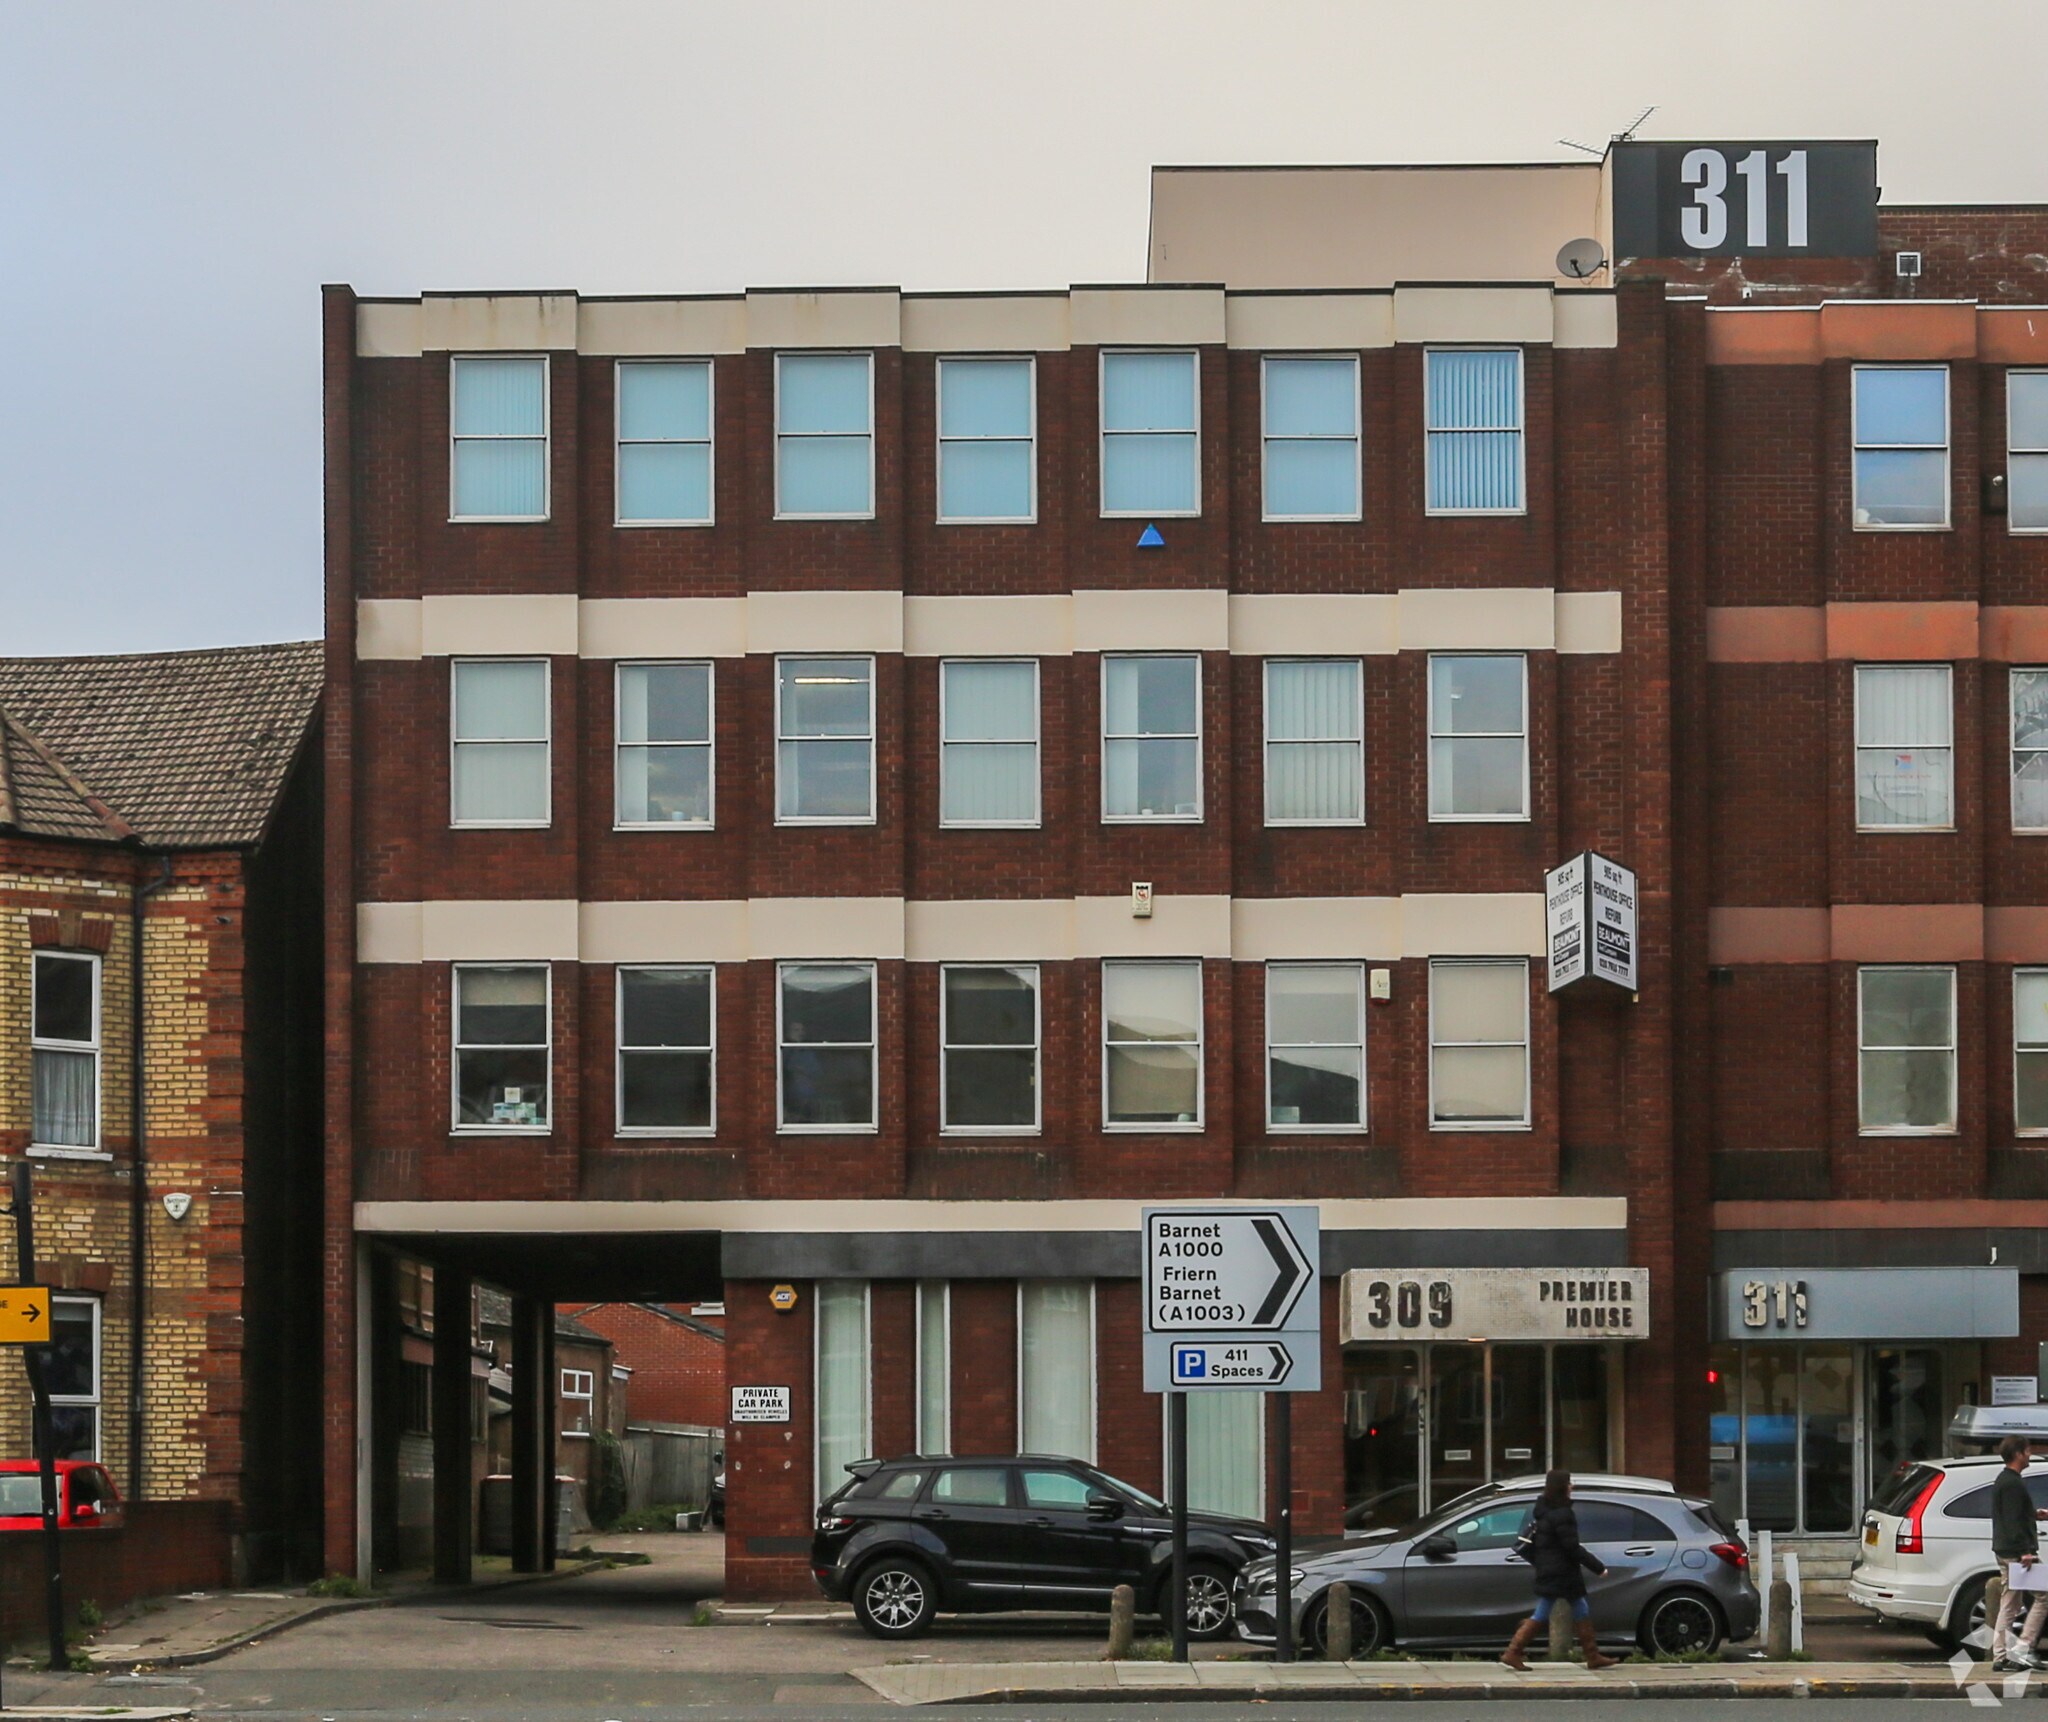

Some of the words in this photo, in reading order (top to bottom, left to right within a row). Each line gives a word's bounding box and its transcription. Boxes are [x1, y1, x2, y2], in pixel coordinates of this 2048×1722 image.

[1681, 148, 1808, 249] 311
[1570, 881, 1583, 900] OFFICE
[1593, 881, 1618, 903] PENTHOUSE
[1619, 892, 1633, 910] OFFICE
[1554, 928, 1580, 951] BEAUMONT
[1598, 926, 1630, 950] BEAUMONT
[1159, 1223, 1221, 1238] Barnet
[1159, 1242, 1223, 1257] A1000
[1163, 1266, 1217, 1281] Friern
[776, 1291, 791, 1301] ADT
[1160, 1286, 1221, 1300] Barnet
[1368, 1281, 1452, 1328] 309
[1540, 1281, 1632, 1301] PREMIER
[1159, 1304, 1246, 1322] (A1003)
[1566, 1307, 1632, 1328] HOUSE
[1225, 1349, 1248, 1361] 411
[1185, 1353, 1202, 1375] P
[1211, 1365, 1264, 1379] Spaces
[743, 1389, 778, 1397] PRIVATE
[738, 1399, 756, 1408] CAR
[760, 1399, 783, 1408] PARK
